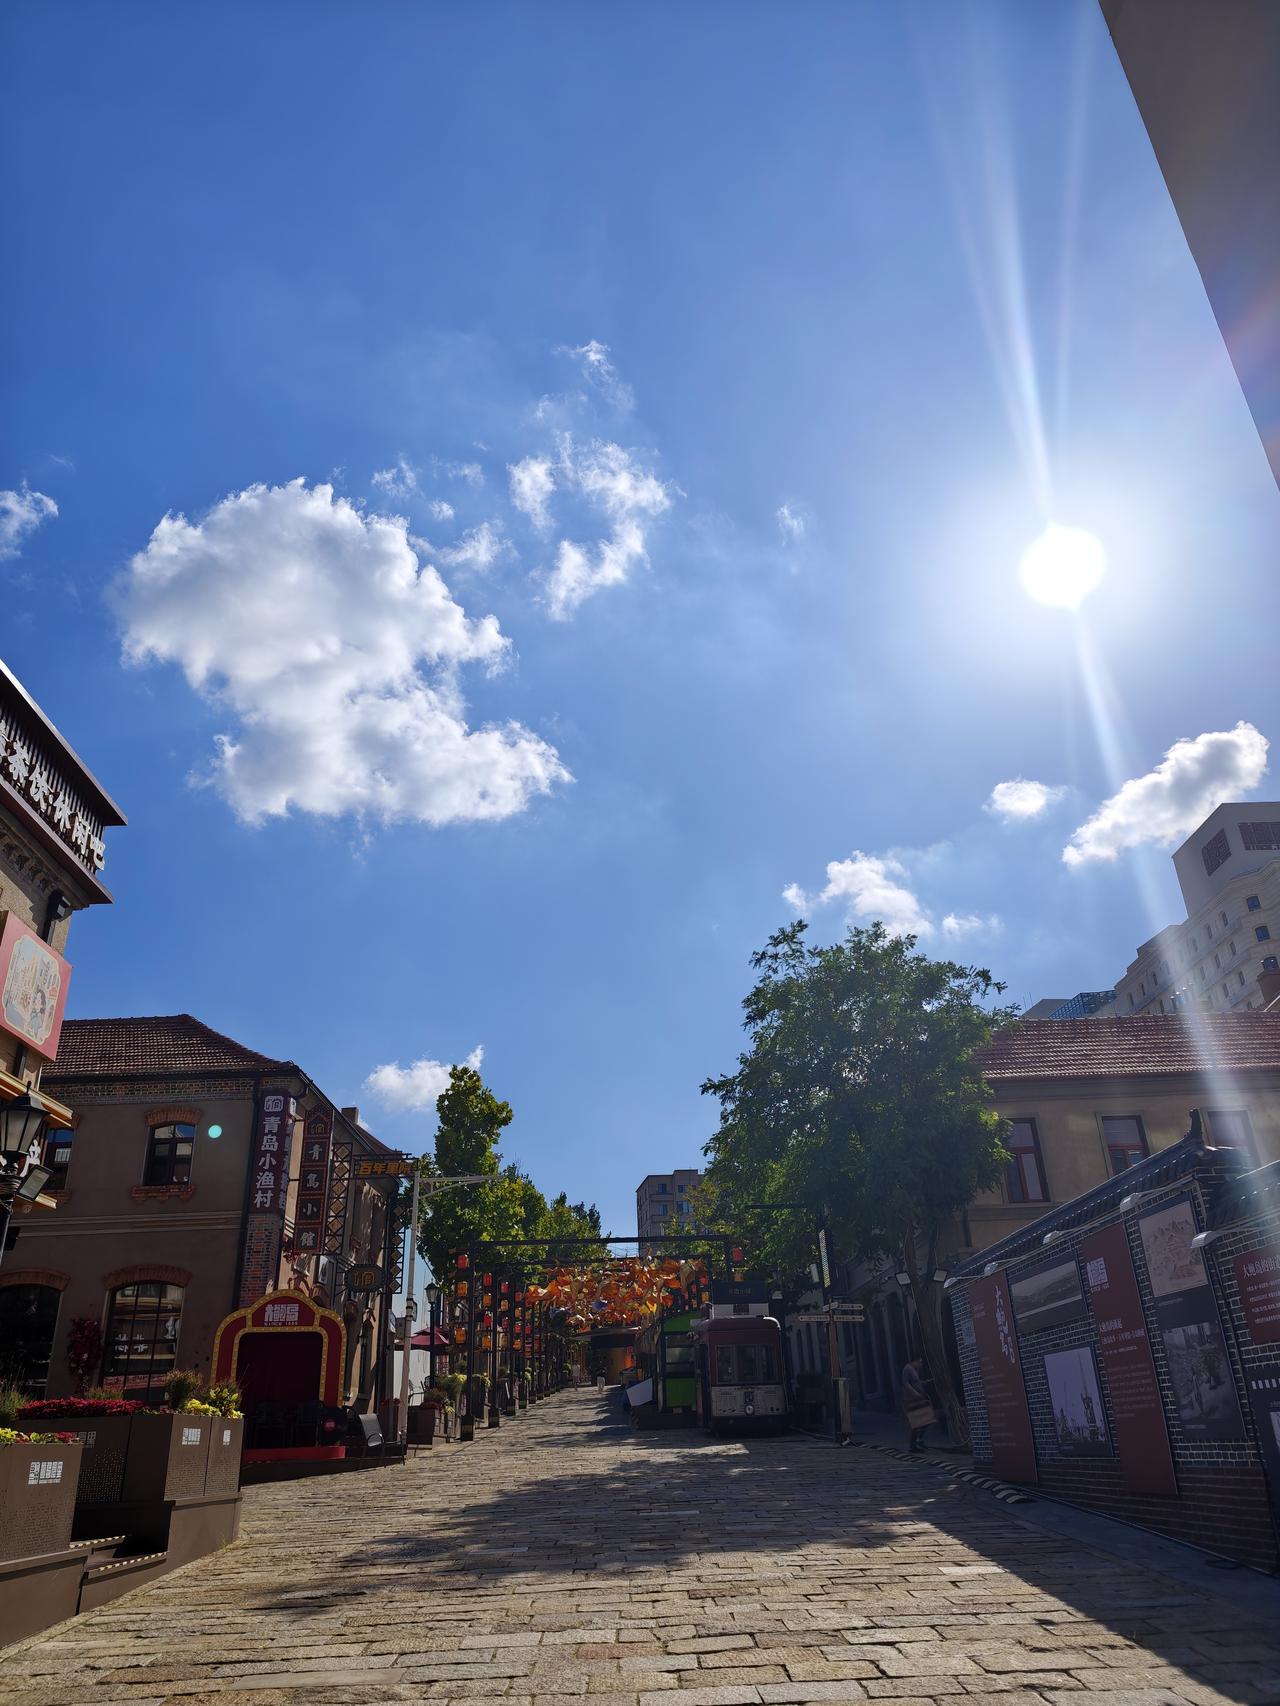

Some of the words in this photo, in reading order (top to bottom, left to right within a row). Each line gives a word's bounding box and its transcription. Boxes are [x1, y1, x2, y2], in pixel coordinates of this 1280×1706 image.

[254, 1116, 281, 1209] 青岛小渔村
